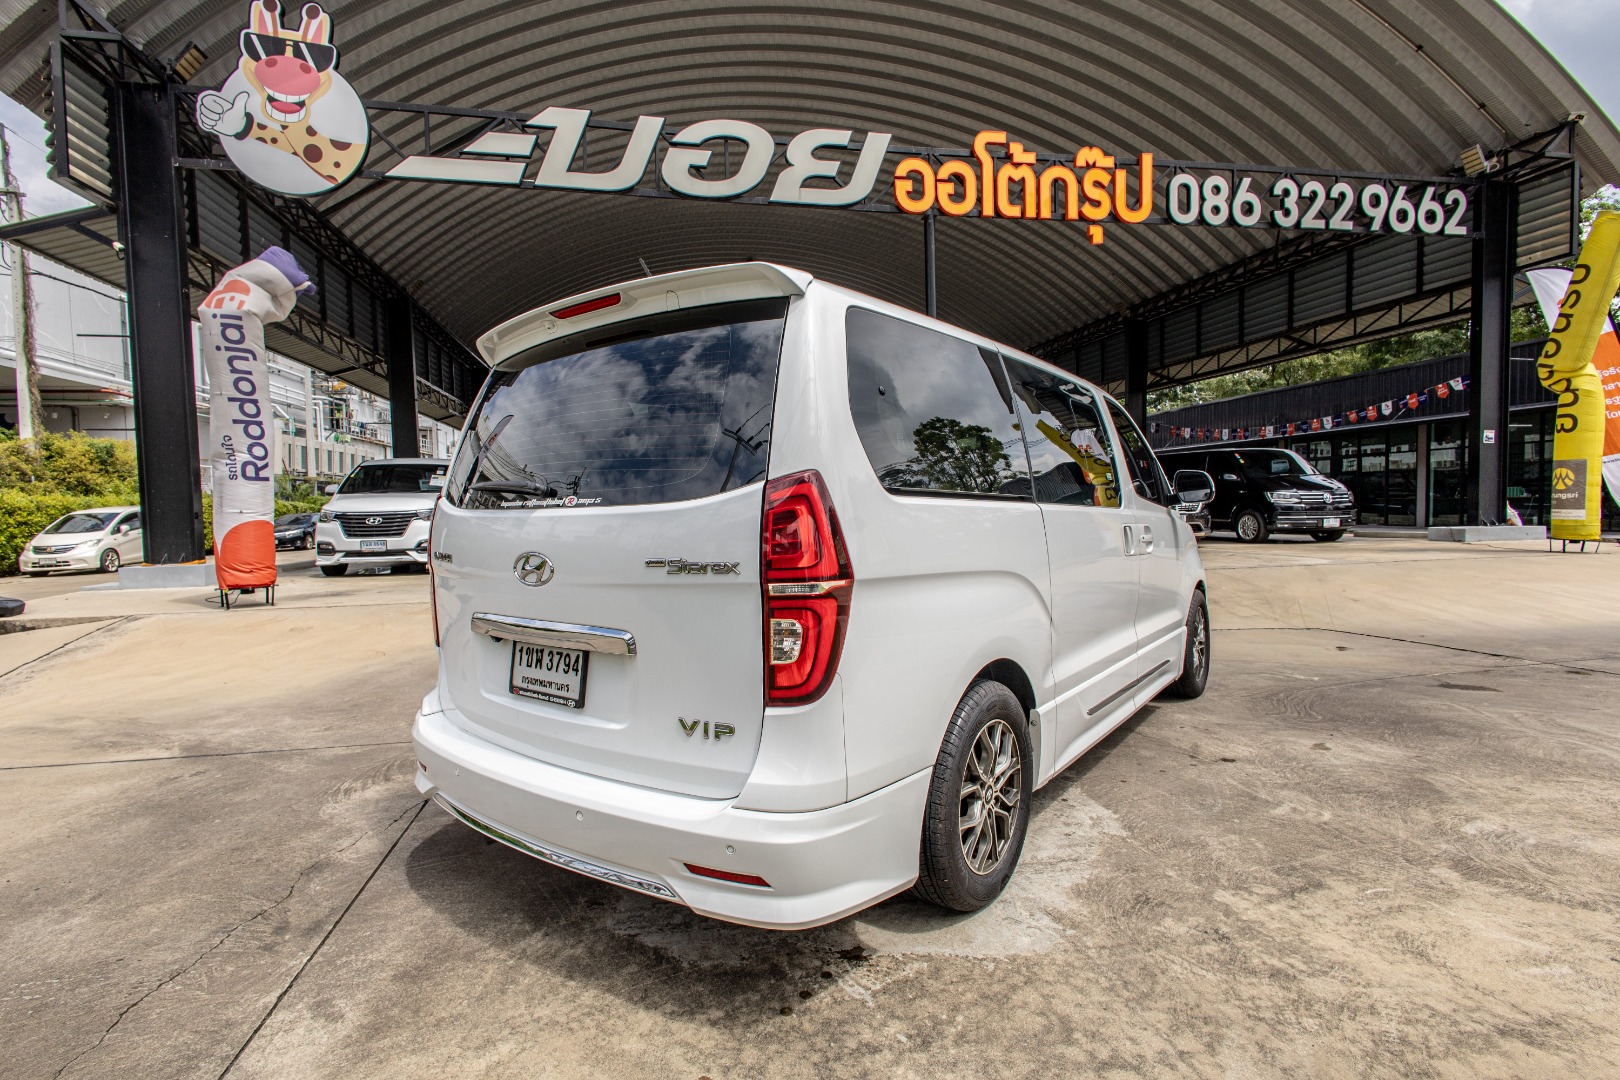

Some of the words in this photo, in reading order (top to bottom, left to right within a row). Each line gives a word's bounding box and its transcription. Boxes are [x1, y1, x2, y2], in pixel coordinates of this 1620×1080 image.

[894, 130, 1153, 245] ออโต้กรุ๊ป
[1166, 173, 1262, 228] 086
[212, 313, 270, 482] Roddonjai
[221, 435, 238, 481] รถโดนใจ
[666, 557, 740, 575] Starex
[546, 650, 580, 677] 3794
[521, 675, 570, 693] กรุงเทพมหานคร
[678, 716, 736, 741] VIP
